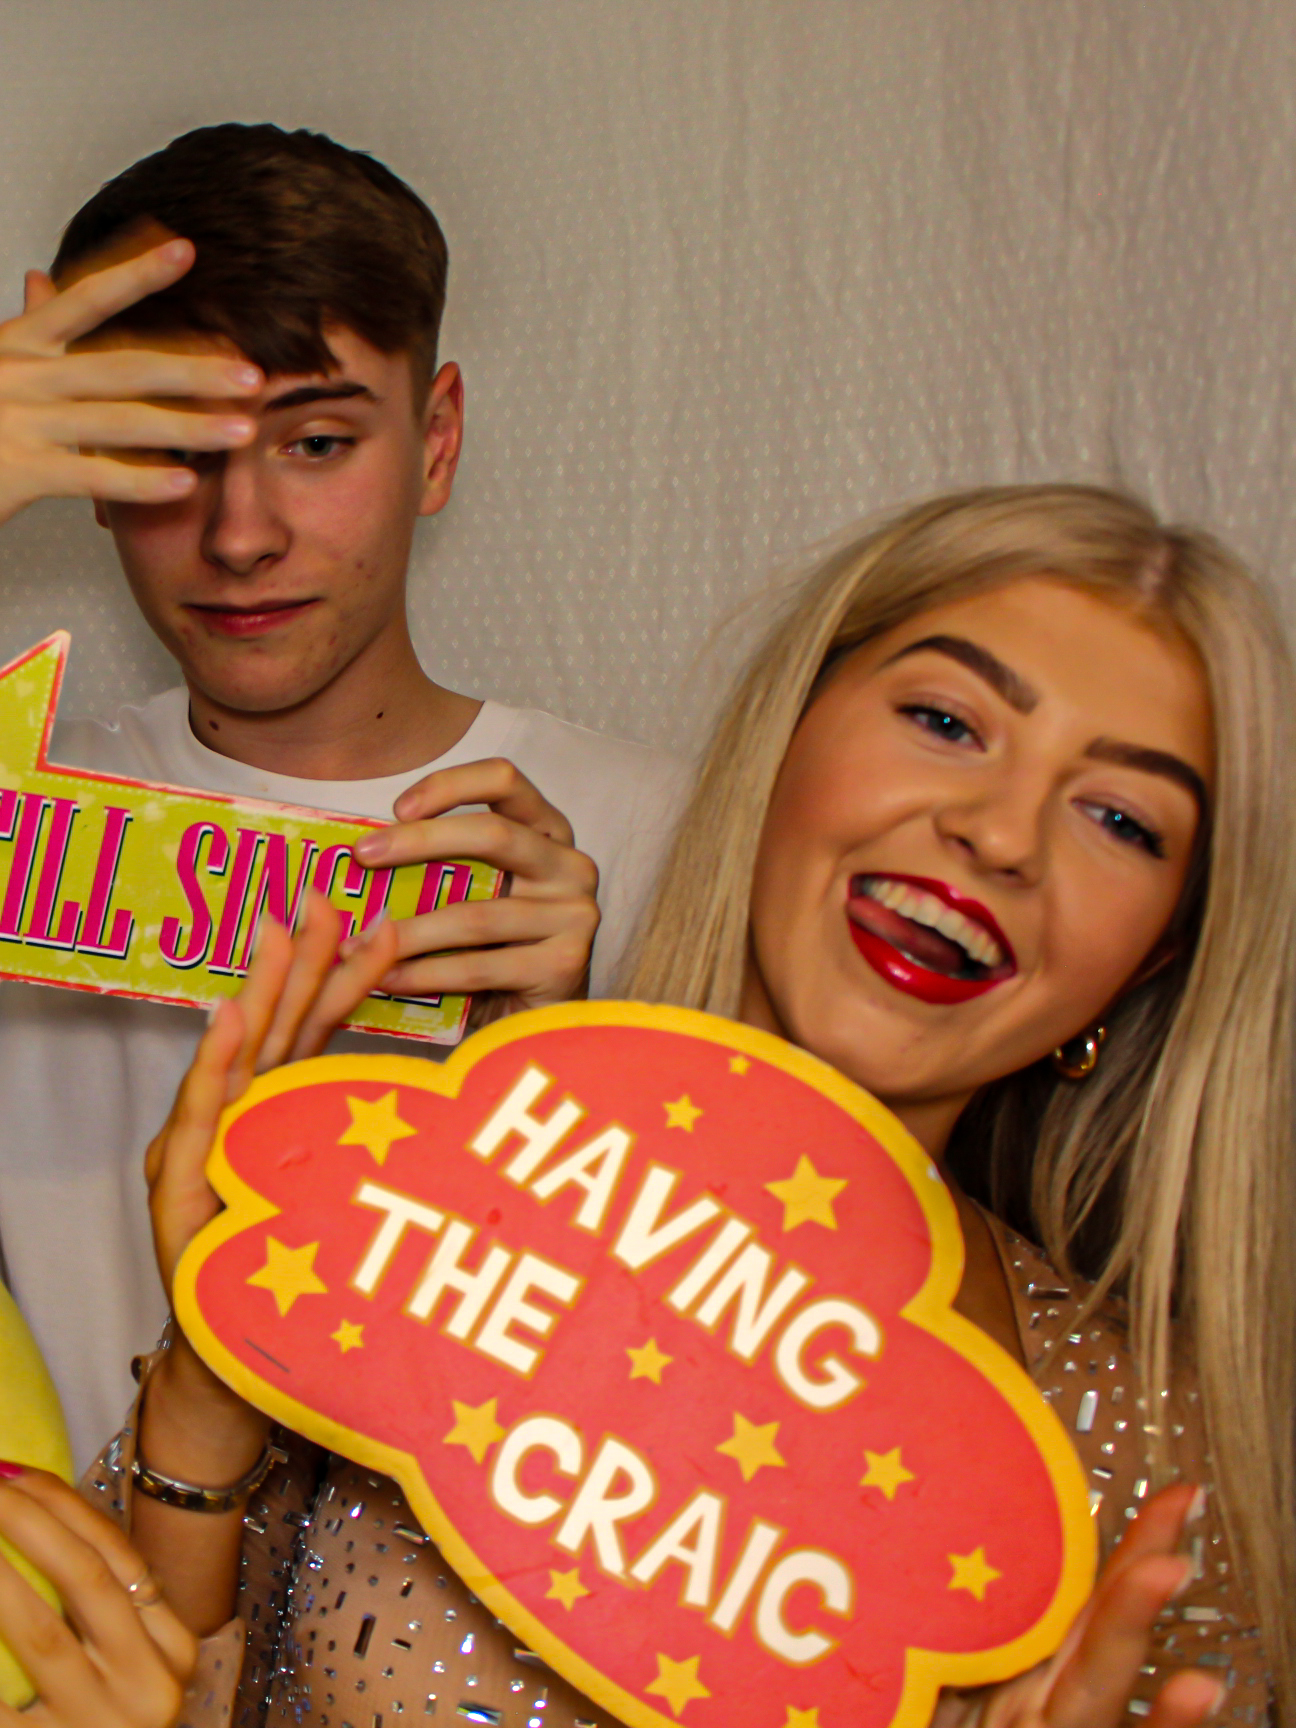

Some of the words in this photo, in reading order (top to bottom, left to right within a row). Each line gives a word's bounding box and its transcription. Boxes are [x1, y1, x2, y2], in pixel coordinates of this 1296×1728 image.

[352, 1182, 582, 1375] THE
[470, 1065, 882, 1409] HAVING
[489, 1415, 852, 1664] CRAIC
